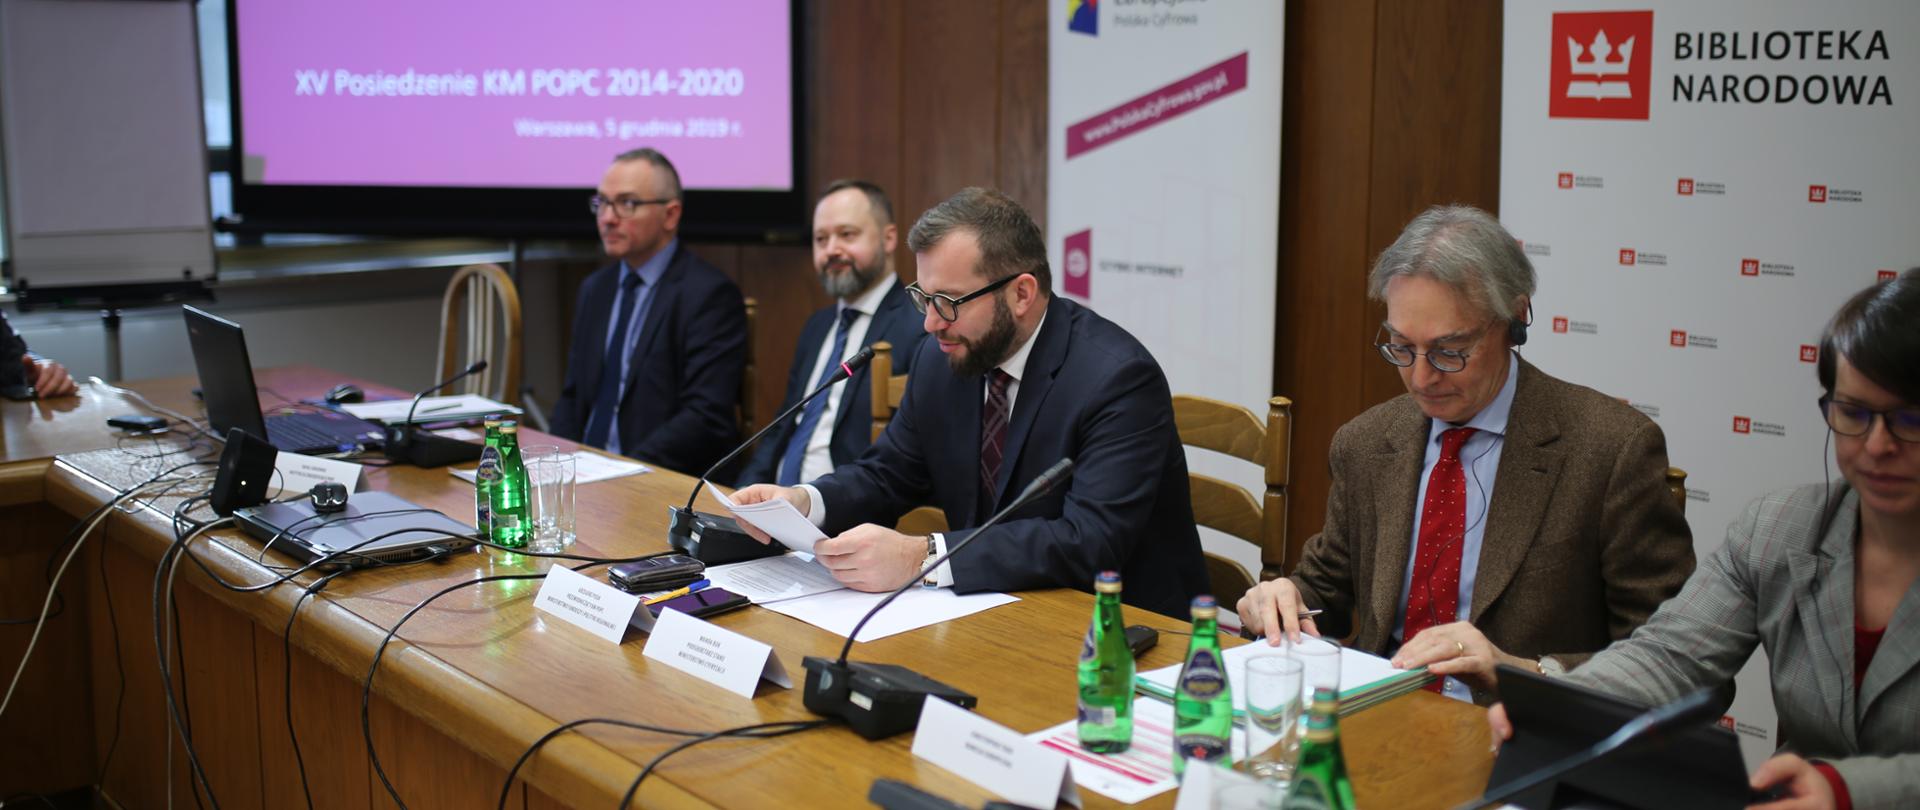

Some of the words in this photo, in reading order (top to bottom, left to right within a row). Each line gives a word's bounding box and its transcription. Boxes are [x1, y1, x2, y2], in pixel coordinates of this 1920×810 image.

[1674, 30, 1890, 60] BIBLIOTEKA
[295, 69, 329, 96] XV
[333, 66, 478, 97] Posiedzenie
[483, 69, 526, 96] KM
[531, 68, 600, 97] POPC
[606, 67, 744, 97] 2014-2020
[1672, 74, 1894, 105] NARODOWA
